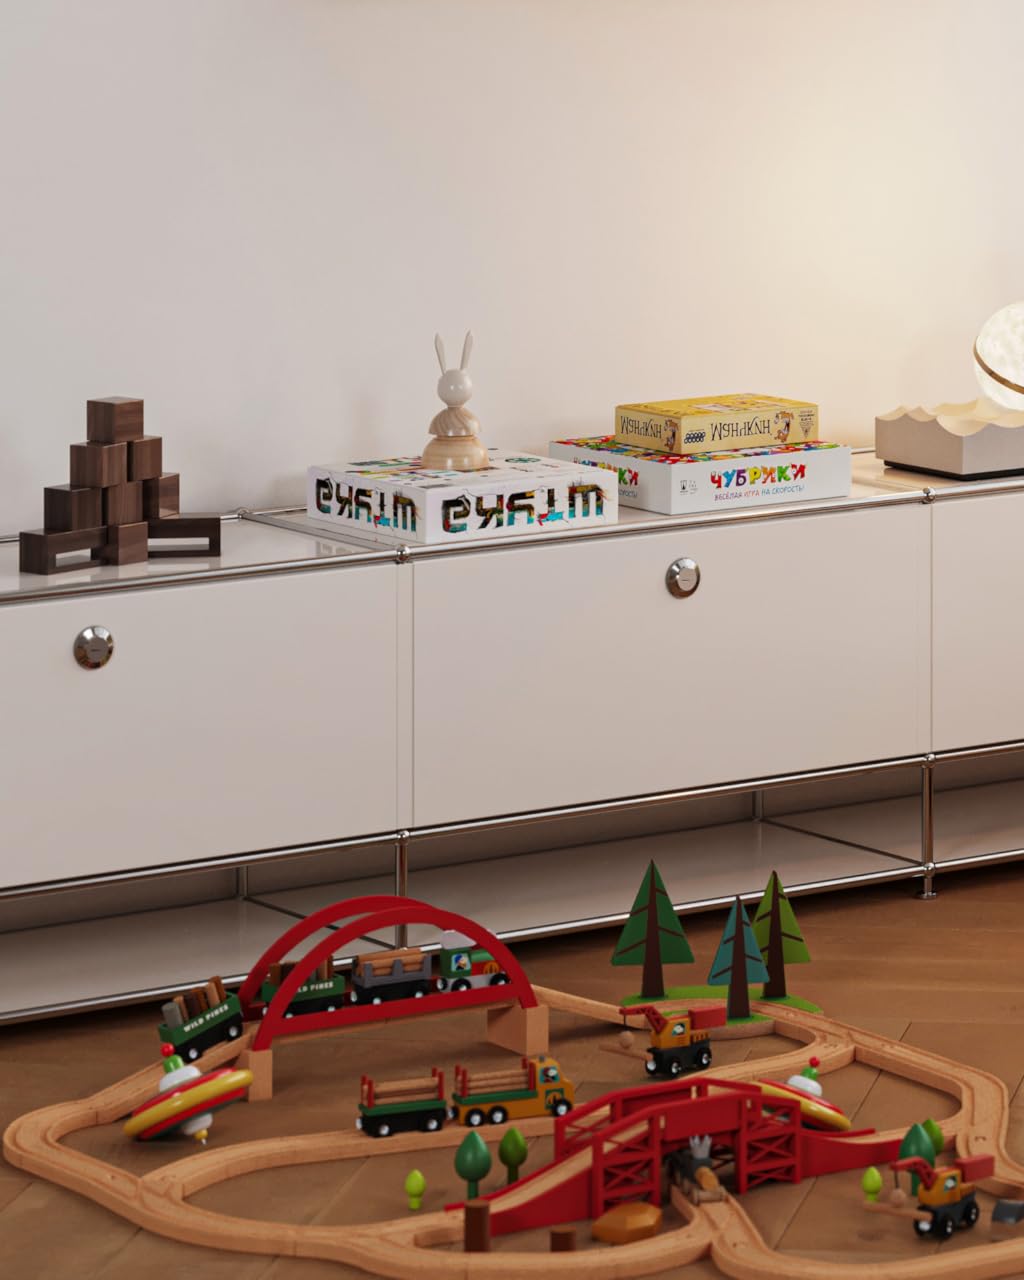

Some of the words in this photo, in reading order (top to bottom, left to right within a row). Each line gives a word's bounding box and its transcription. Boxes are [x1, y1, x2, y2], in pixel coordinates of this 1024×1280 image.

[710, 463, 806, 489] ЧУБРИКИ
[310, 981, 334, 991] PINES
[183, 1018, 204, 1033] WILD
[205, 1004, 229, 1020] PINES
